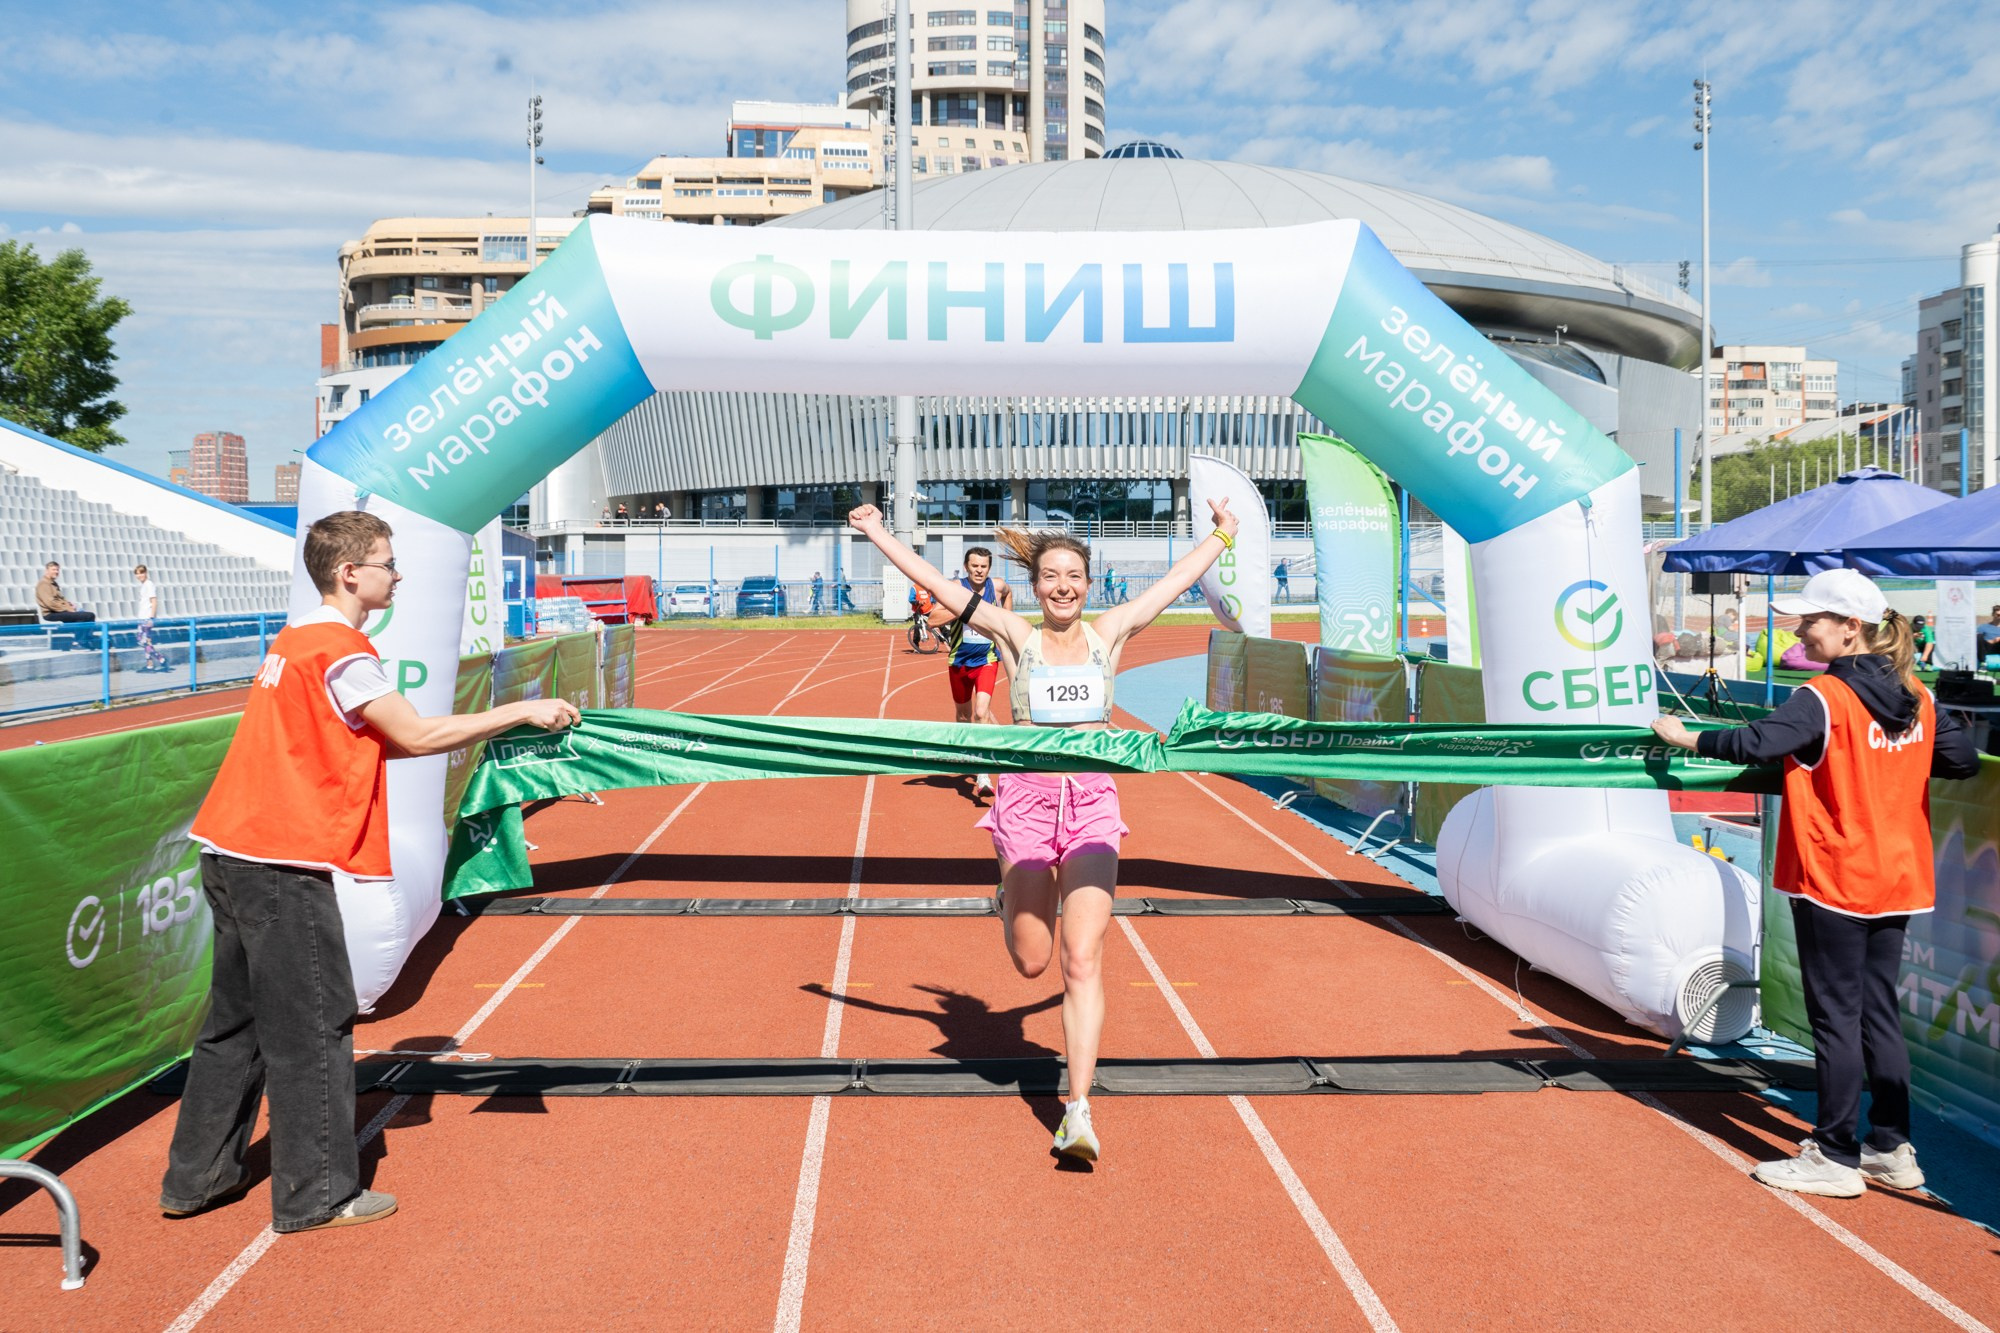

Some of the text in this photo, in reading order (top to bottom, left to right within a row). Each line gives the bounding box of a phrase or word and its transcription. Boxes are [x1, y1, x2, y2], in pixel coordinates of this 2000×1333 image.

[709, 254, 1236, 344] ФИНИШ
[383, 290, 569, 452] зелёный
[1380, 306, 1567, 462] зелёный
[407, 325, 603, 490] марафон
[1344, 335, 1540, 499] марафон
[1317, 502, 1388, 518] зелёный
[1317, 517, 1388, 533] марафон
[1046, 685, 1089, 702] 1293
[1522, 664, 1652, 711] СБЕР
[501, 740, 561, 762] Прайм
[1338, 733, 1395, 746] Прайм
[1614, 744, 1681, 760] СБЕР
[137, 867, 197, 936] 185
